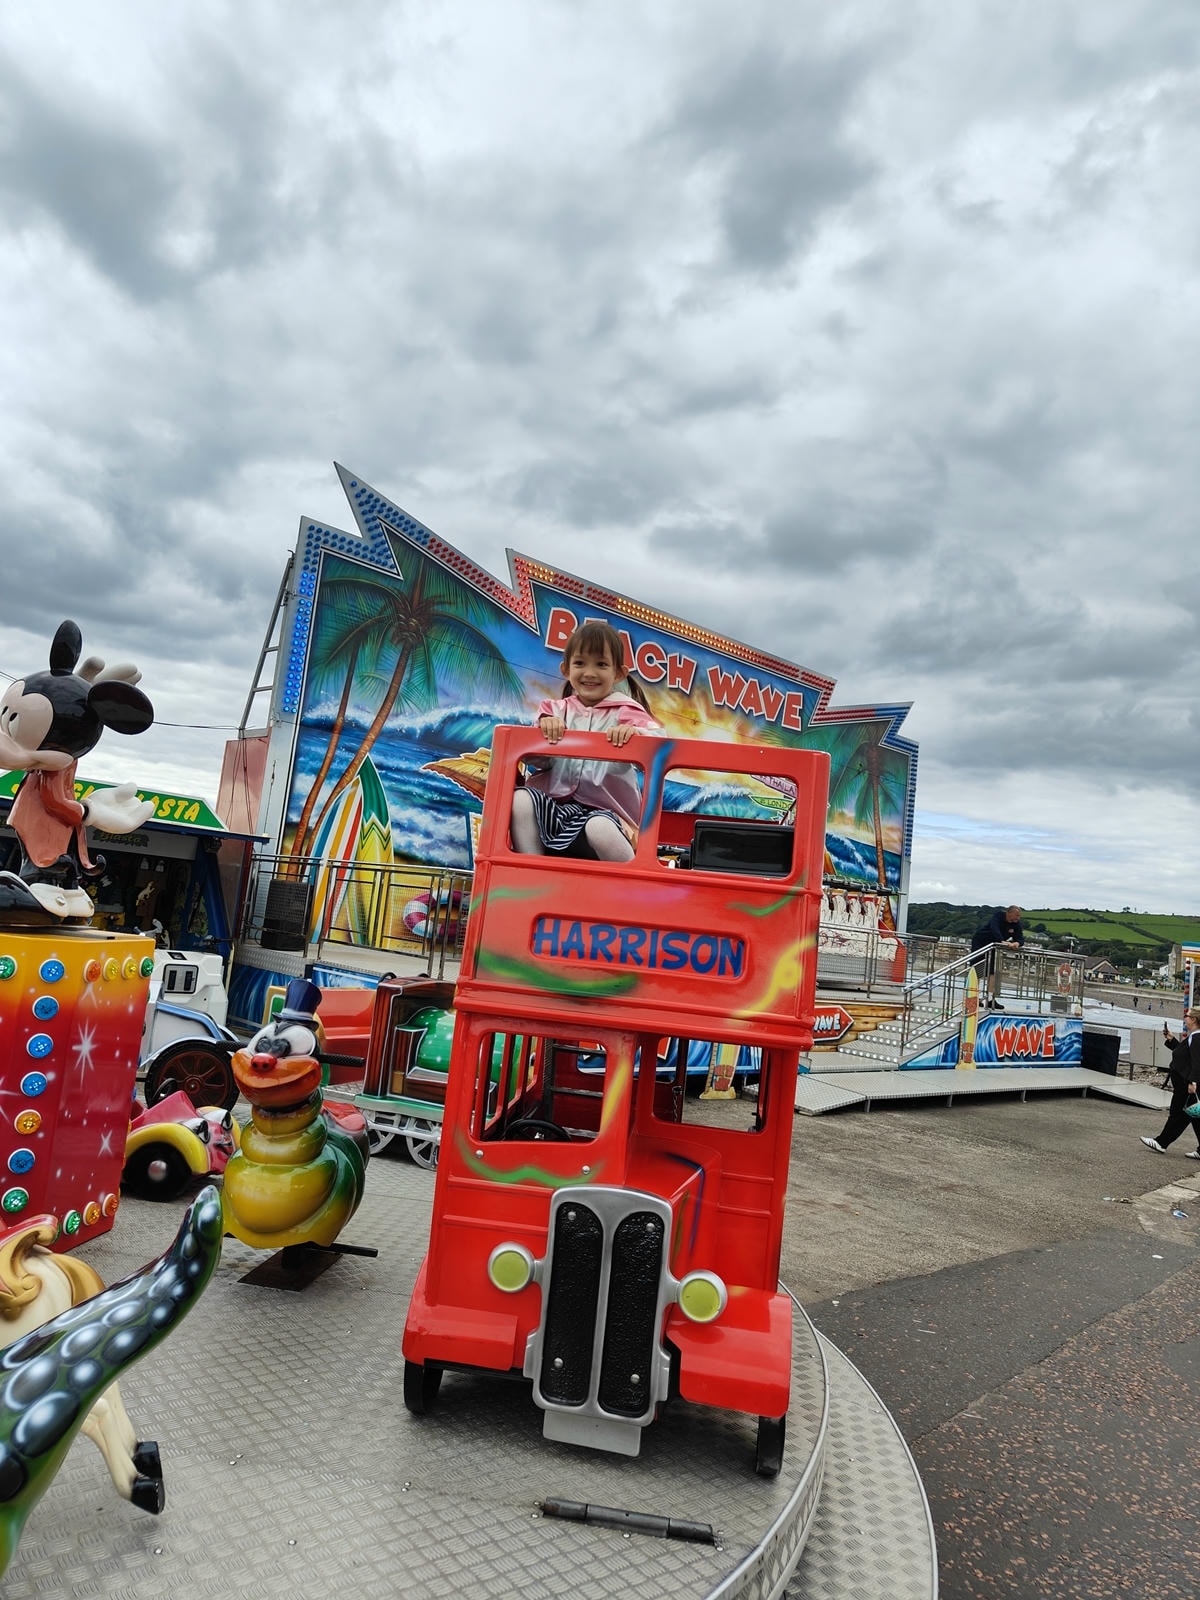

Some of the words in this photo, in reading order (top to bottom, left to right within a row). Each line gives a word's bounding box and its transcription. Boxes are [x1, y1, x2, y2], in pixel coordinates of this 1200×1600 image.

[707, 665, 803, 731] WAVE
[533, 917, 745, 978] HARRISON
[994, 1023, 1055, 1058] WAVE
